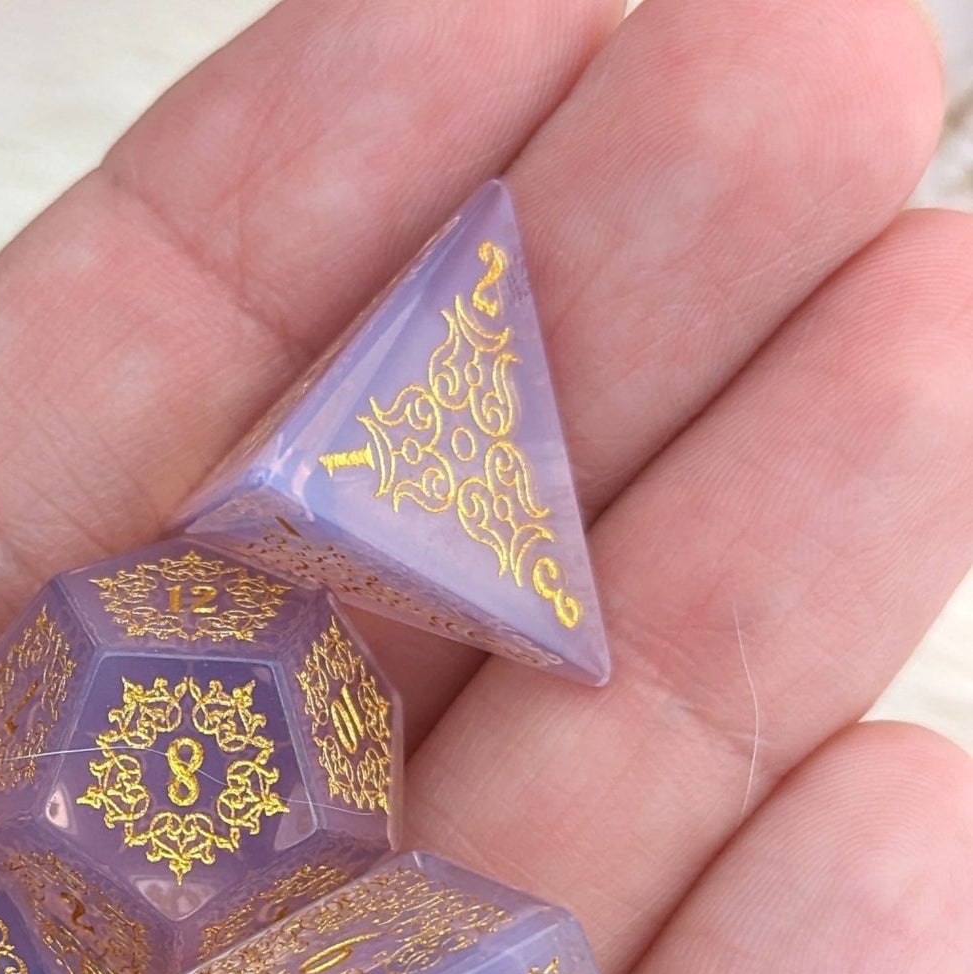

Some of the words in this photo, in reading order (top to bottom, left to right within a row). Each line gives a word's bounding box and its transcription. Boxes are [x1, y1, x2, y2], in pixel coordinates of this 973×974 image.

[473, 241, 509, 319] 2
[319, 441, 374, 477] 1
[166, 583, 221, 614] 12
[532, 556, 583, 631] 3
[331, 684, 365, 754] 10
[167, 737, 205, 807] 8
